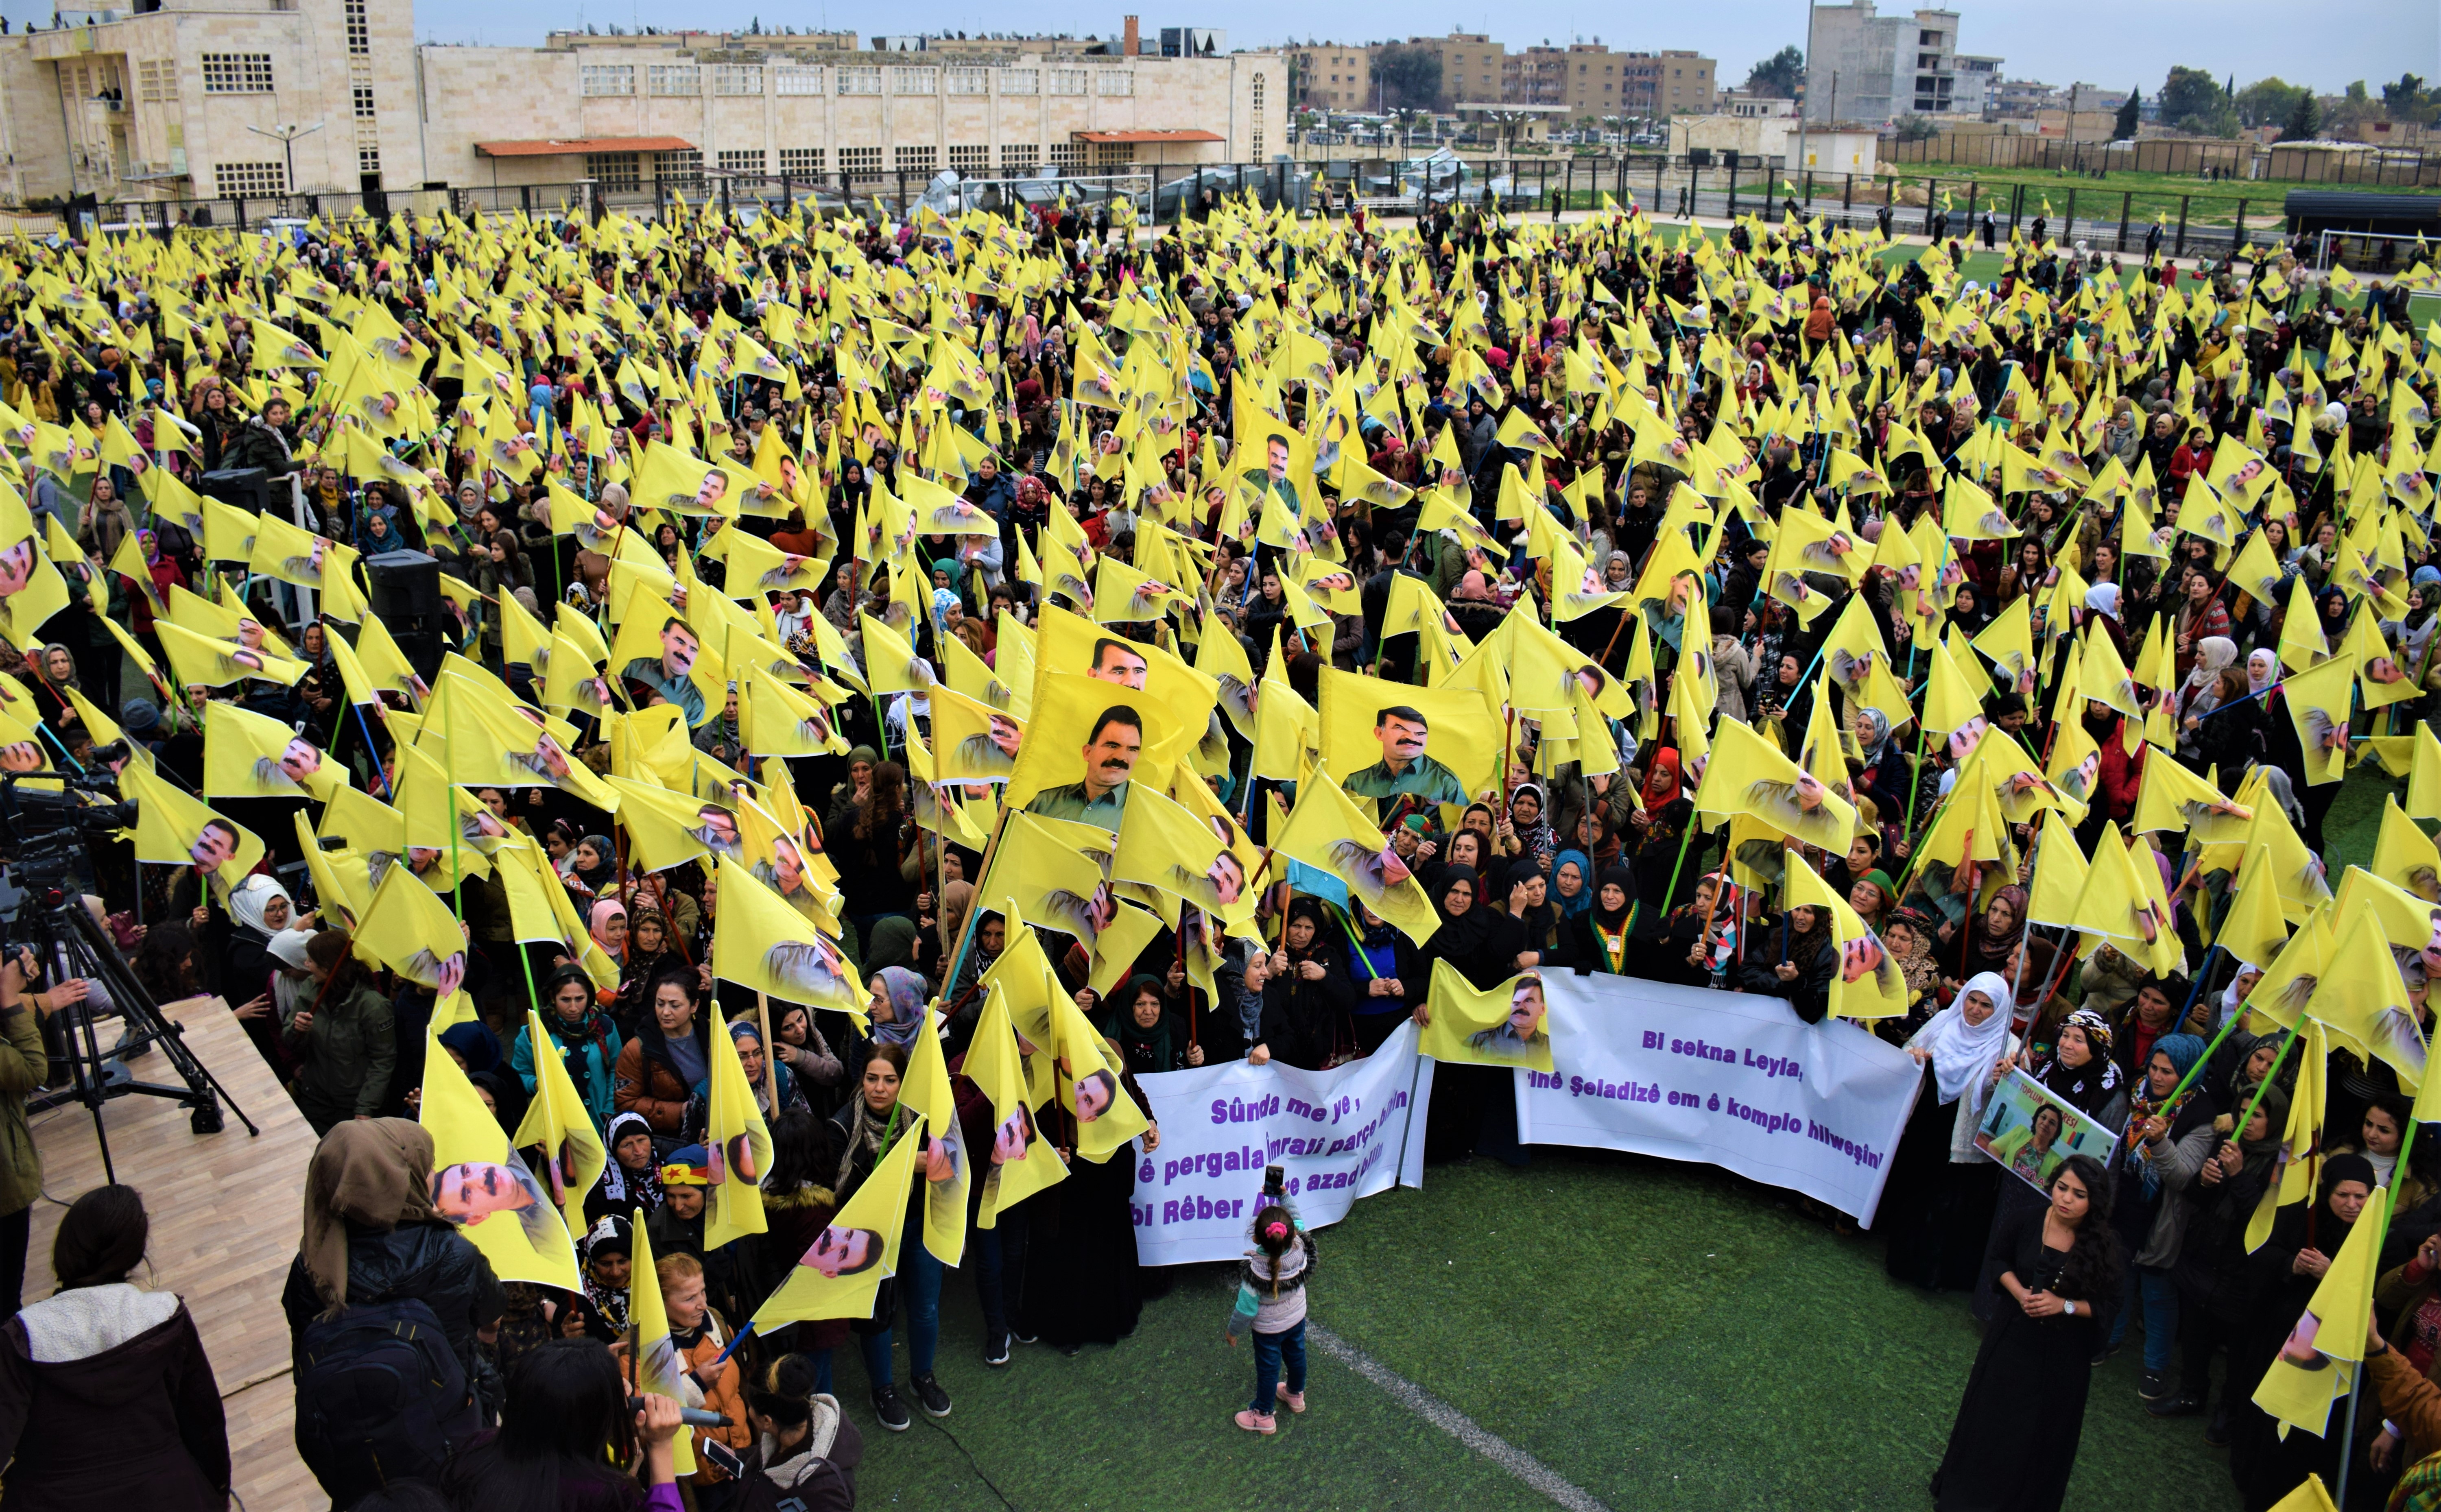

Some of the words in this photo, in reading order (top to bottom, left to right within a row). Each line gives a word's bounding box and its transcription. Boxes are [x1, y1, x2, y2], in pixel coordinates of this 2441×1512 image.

[1642, 1030, 1665, 1050] Bi
[1670, 1039, 1736, 1064] sekna
[1743, 1048, 1803, 1082] Leyla,
[1211, 1093, 1280, 1124] Sûnda
[1286, 1097, 1327, 1122] me
[1570, 1075, 1660, 1103] Şeladizê
[1667, 1090, 1700, 1108] em
[1707, 1093, 1720, 1112] ê
[1727, 1097, 1802, 1134] komplo
[1138, 1157, 1155, 1183] ê
[1164, 1145, 1264, 1186] pergala
[1325, 1119, 1377, 1156] parçe
[2014, 1159, 2045, 1187] LEYLA
[1163, 1195, 1243, 1225] Rêber
[1306, 1164, 1360, 1191] azad
